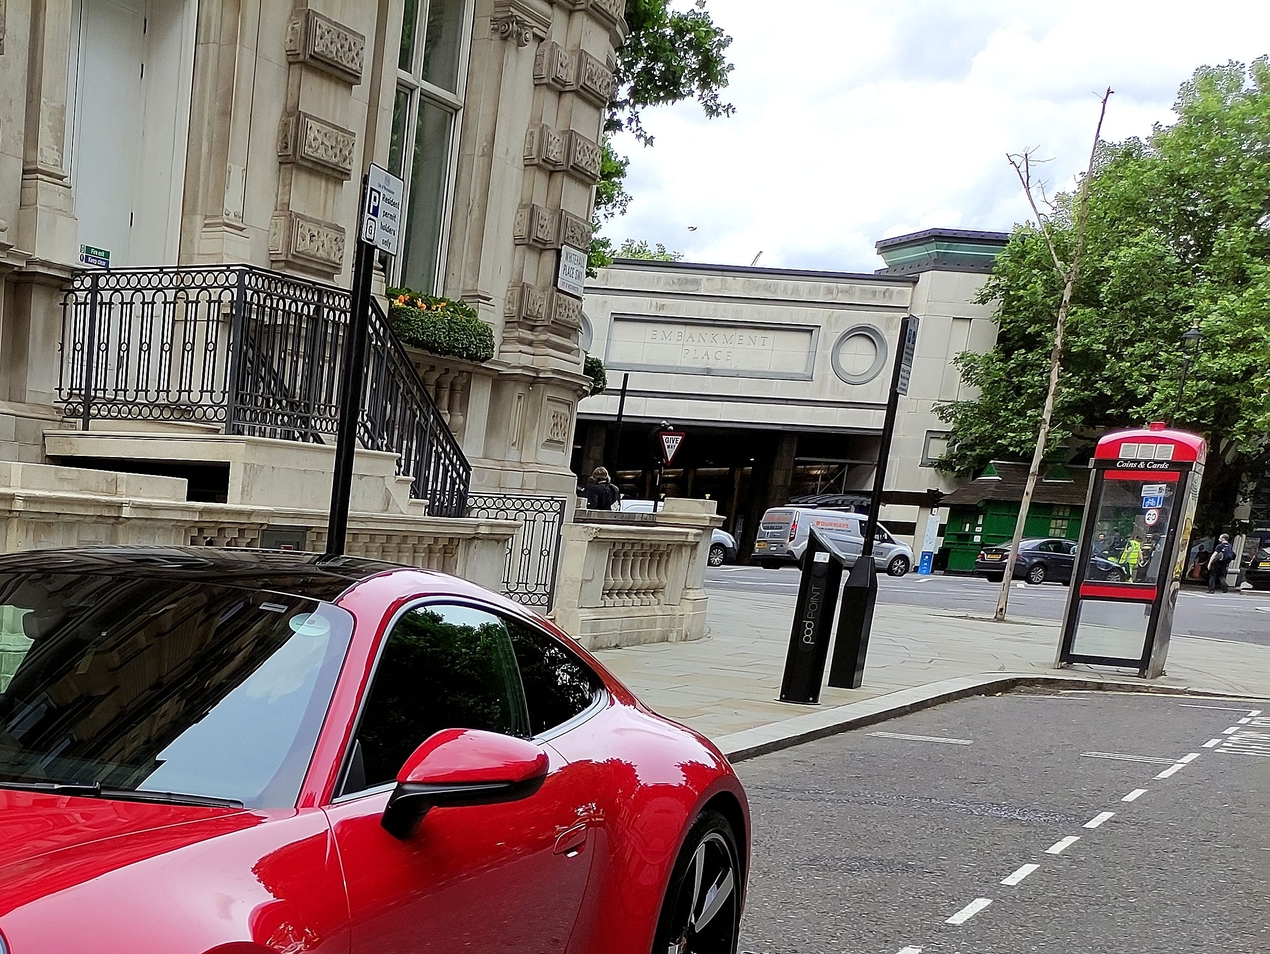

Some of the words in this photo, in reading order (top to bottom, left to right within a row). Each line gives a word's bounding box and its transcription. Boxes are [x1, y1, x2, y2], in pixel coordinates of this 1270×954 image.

[370, 190, 379, 214] P
[382, 193, 400, 210] Resident
[382, 210, 396, 222] permit
[380, 221, 396, 237] holders
[381, 239, 391, 250] only
[562, 264, 574, 279] PLACE
[650, 329, 769, 346] EMBANKMENT
[683, 348, 732, 361] PLACE
[665, 436, 680, 444] GIVE
[1116, 460, 1137, 468] Coins
[1146, 461, 1169, 469] Cards
[1146, 512, 1156, 521] 20
[806, 584, 822, 619] POINT
[802, 620, 815, 645] pod
